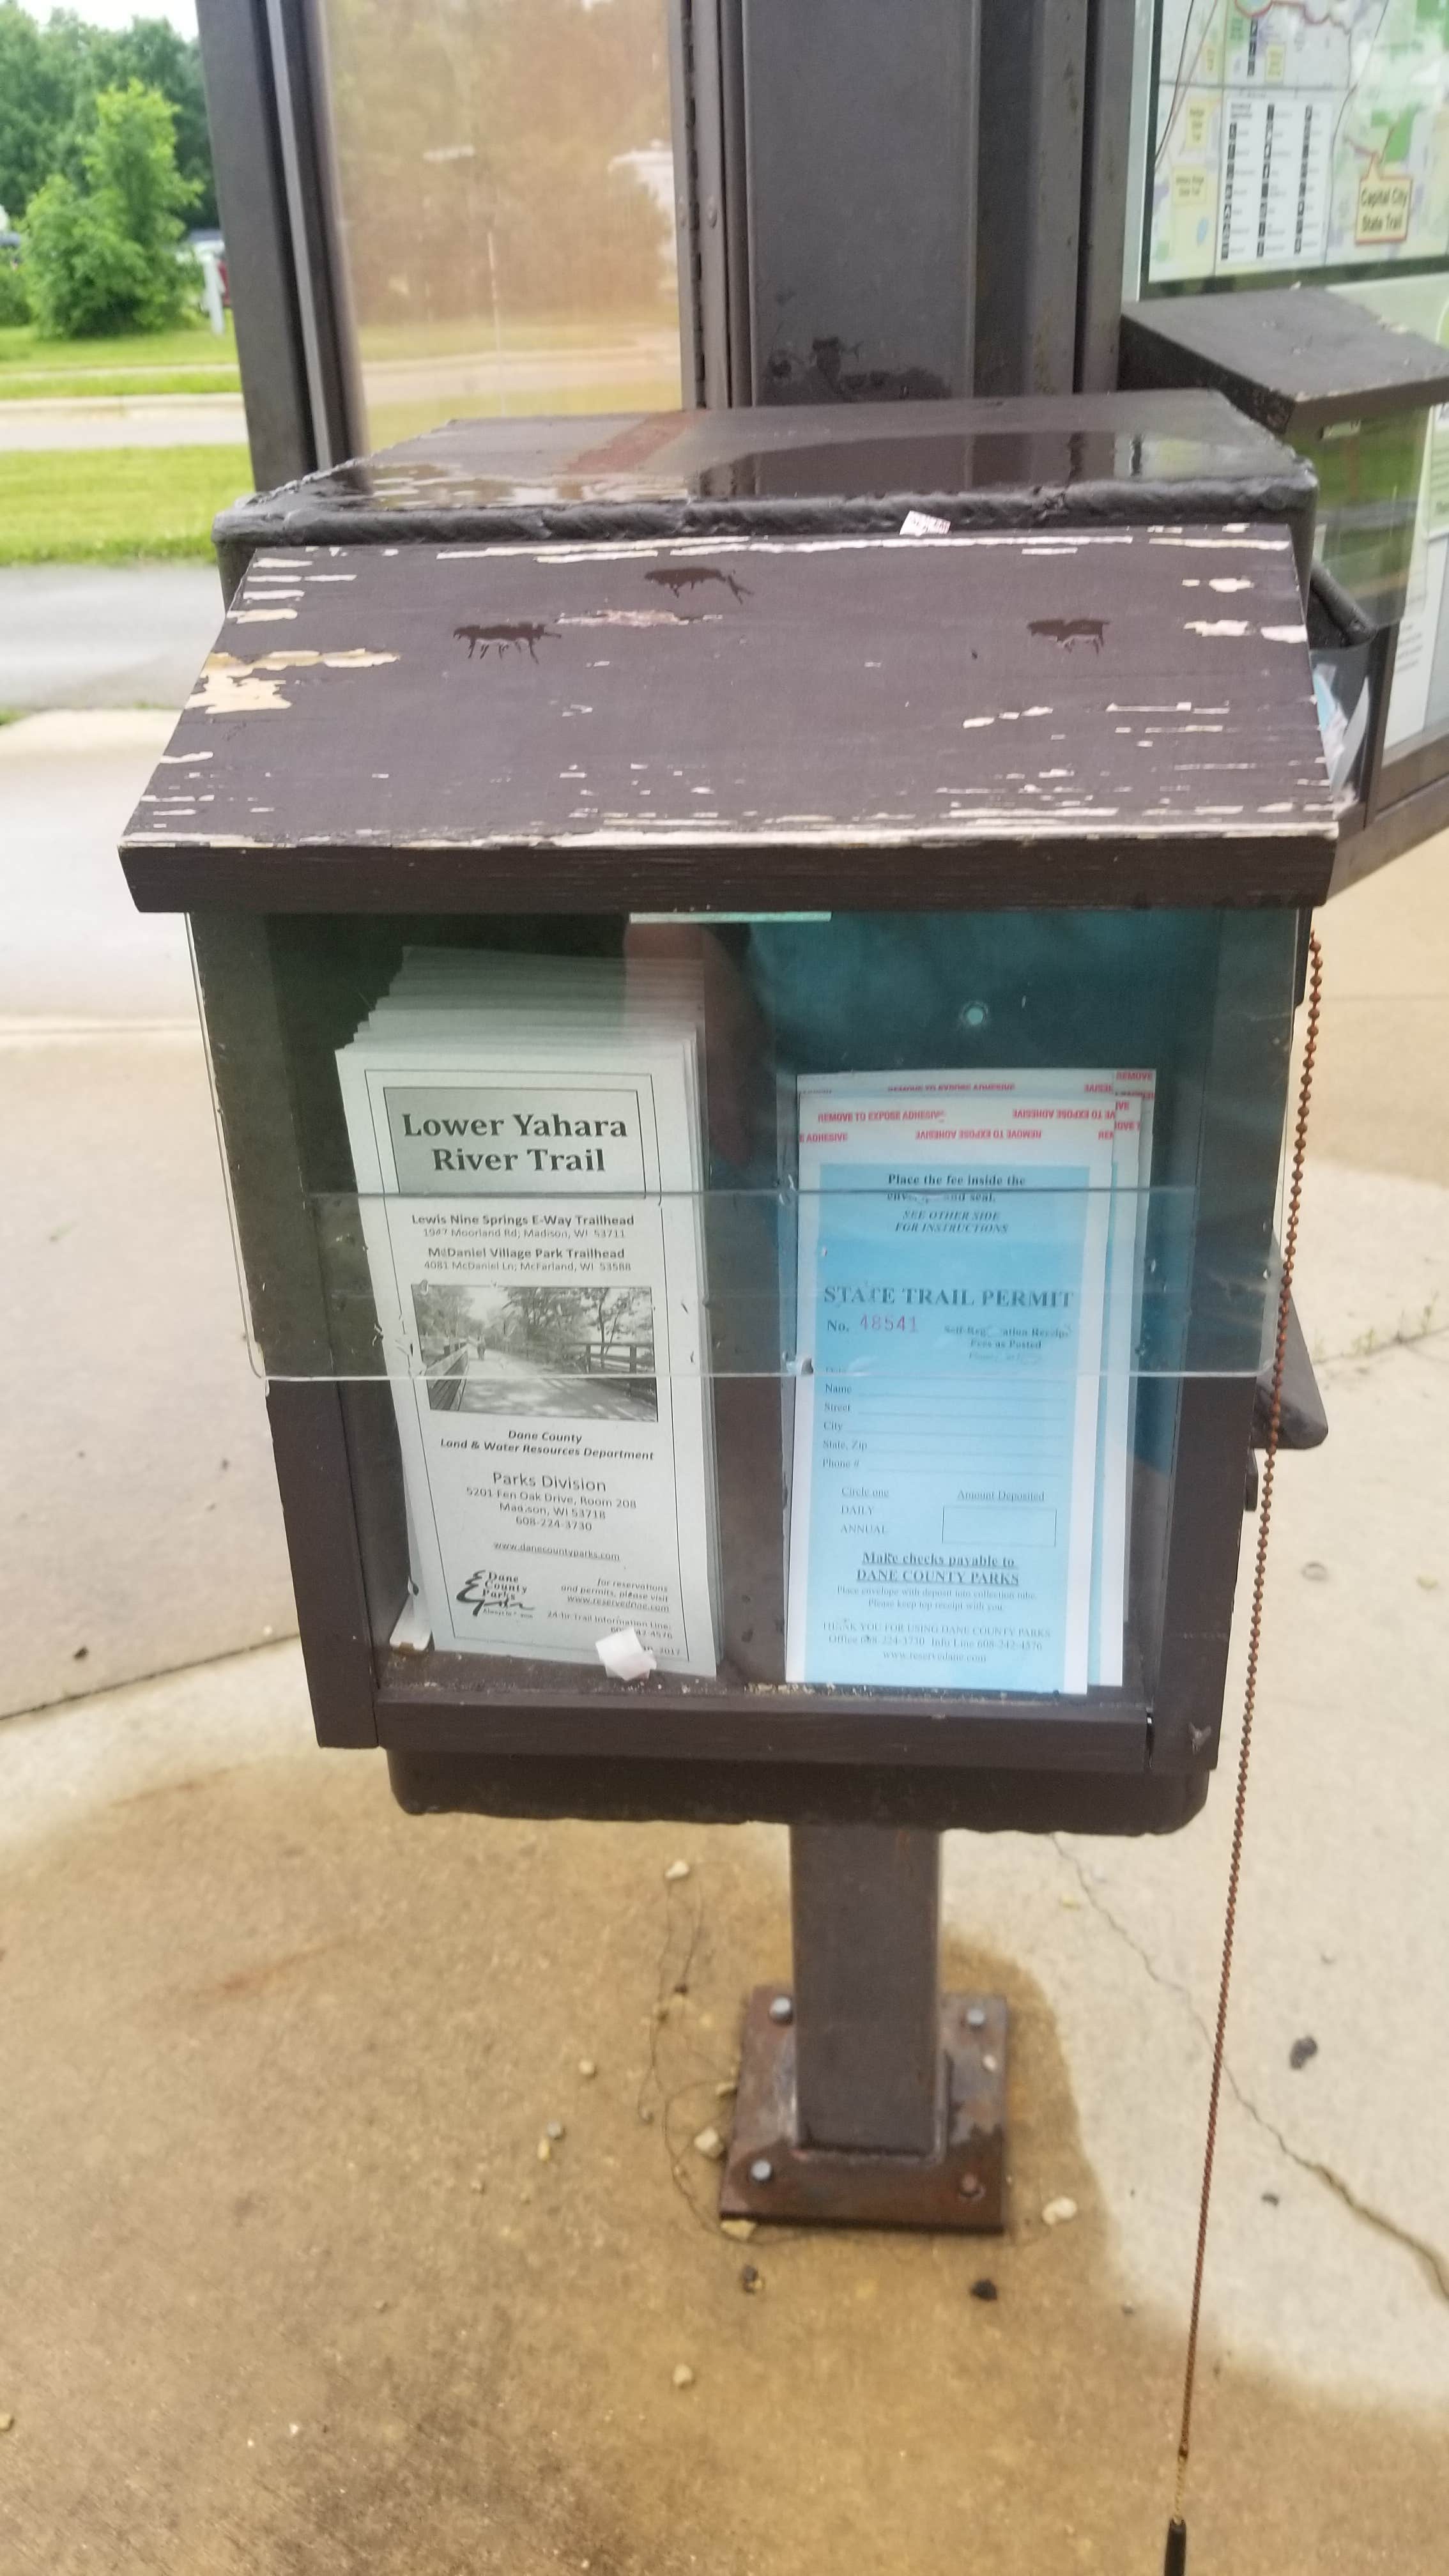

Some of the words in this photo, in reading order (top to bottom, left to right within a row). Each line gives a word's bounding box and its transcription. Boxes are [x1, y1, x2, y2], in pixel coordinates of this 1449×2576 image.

[1361, 187, 1390, 209] Capital
[1392, 187, 1407, 208] City
[1362, 215, 1383, 231] State
[1384, 213, 1402, 230] Trail
[818, 1112, 853, 1123] REMOVE
[855, 1112, 866, 1122] TO
[868, 1110, 900, 1121] EXPOSE
[902, 1110, 946, 1121] ADHESIVE
[1013, 1109, 1054, 1119] ADHESIVE
[402, 1114, 505, 1137] Lower
[513, 1114, 628, 1137] Yahara
[806, 1133, 848, 1143] ADHESIVE
[916, 1130, 957, 1140] ADHESIVE
[959, 1130, 991, 1140] EXPOSE
[1006, 1130, 1042, 1140] REMOVE
[433, 1148, 518, 1171] River
[527, 1148, 606, 1172] Trail
[888, 1174, 920, 1185] Place
[924, 1174, 942, 1185] the
[947, 1174, 963, 1186] fee
[968, 1174, 1002, 1186] inside
[1007, 1174, 1025, 1186] the
[970, 1193, 995, 1203] seal.
[412, 1215, 447, 1225] Lewis
[450, 1215, 479, 1225] Nine
[482, 1215, 528, 1227] Springs
[532, 1215, 572, 1227] E-Way
[575, 1215, 634, 1225] Trailhead
[903, 1211, 926, 1220] SEE
[929, 1211, 969, 1221] OTHER
[973, 1211, 999, 1221] SIDE
[452, 1229, 500, 1238] Moorland
[524, 1229, 571, 1239] Madison,
[574, 1229, 588, 1238] WI
[895, 1223, 919, 1232] FOR
[922, 1223, 1009, 1234] INSTRUCTIONS
[428, 1248, 486, 1258] McDaniel
[490, 1248, 531, 1260] Village
[535, 1248, 562, 1258] Park
[566, 1248, 625, 1259] Trailhead
[452, 1262, 499, 1271] McDaniel
[521, 1262, 576, 1272] McFarland,
[580, 1262, 594, 1271] WI
[824, 1287, 896, 1305] STATE
[901, 1288, 974, 1306] TRAIL
[981, 1289, 1075, 1308] PERMIT
[827, 1319, 850, 1333] No.
[859, 1314, 918, 1333] 48541
[1009, 1340, 1041, 1349] Posted
[825, 1384, 852, 1394] Name
[824, 1403, 850, 1413] Street
[824, 1422, 843, 1432] City
[509, 1430, 538, 1440] Dane
[542, 1431, 582, 1444] County
[441, 1438, 467, 1449] Land
[471, 1440, 479, 1450] &
[484, 1441, 519, 1452] Water
[523, 1445, 580, 1456] Resources
[584, 1447, 654, 1461] Department
[823, 1440, 848, 1452] State,
[852, 1440, 867, 1452] Zip
[822, 1458, 851, 1468] Phone
[493, 1471, 536, 1487] Parks
[542, 1475, 607, 1492] Division
[466, 1487, 492, 1498] 5201
[496, 1489, 516, 1500] Fen
[520, 1491, 541, 1501] Oak
[544, 1493, 576, 1505] Drive,
[580, 1496, 612, 1508] Room
[616, 1499, 637, 1509] 208
[841, 1487, 870, 1498] Circle
[873, 1490, 889, 1498] one
[958, 1490, 995, 1501] Amount
[999, 1491, 1045, 1503] Deposited
[500, 1503, 549, 1516] Madison,
[553, 1506, 568, 1516] WI
[841, 1505, 875, 1515] DAILY
[840, 1524, 887, 1534] ANNUAL
[493, 1541, 620, 1561] www.danecountyparks.com
[863, 1552, 899, 1565] Make
[903, 1552, 944, 1565] checks
[949, 1554, 998, 1568] payable
[1002, 1556, 1015, 1568] to
[489, 1572, 519, 1583] Dane
[857, 1568, 898, 1581] DANE
[903, 1570, 965, 1583] COUNTY
[971, 1571, 1019, 1586] PARKS
[484, 1580, 528, 1595] County
[597, 1578, 610, 1586] for
[613, 1580, 667, 1592] reservations
[482, 1588, 516, 1600] Parks
[862, 1586, 899, 1597] envelope
[902, 1586, 919, 1596] with
[651, 1594, 668, 1602] visit
[868, 1598, 894, 1607] Please
[898, 1599, 916, 1611] keep
[574, 1613, 592, 1623] Trail
[595, 1615, 648, 1628] Information
[941, 1625, 967, 1635] DANE
[972, 1627, 1013, 1636] COUNTY
[1018, 1629, 1051, 1638] PARKS
